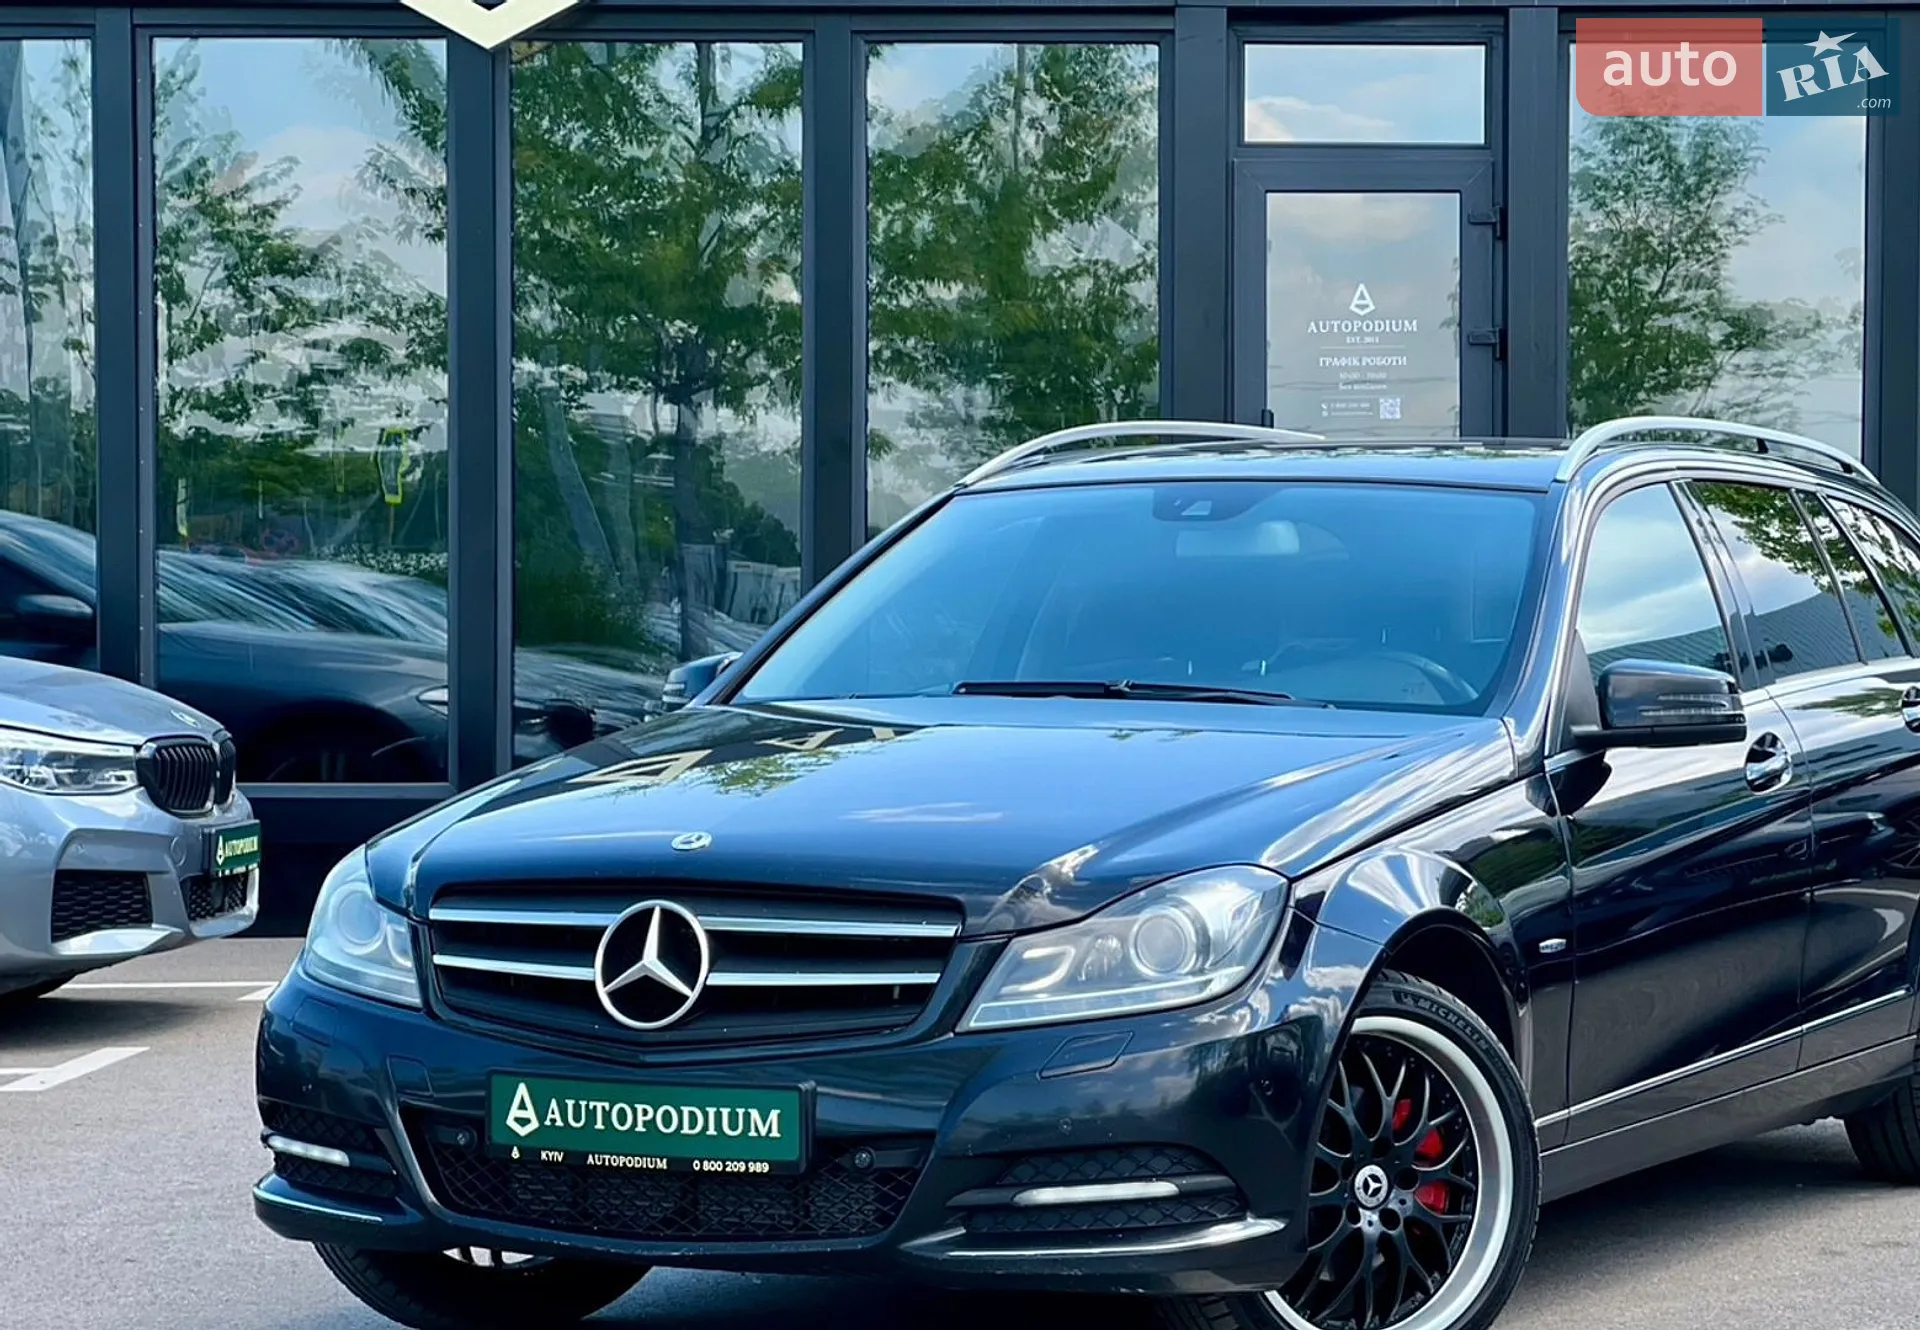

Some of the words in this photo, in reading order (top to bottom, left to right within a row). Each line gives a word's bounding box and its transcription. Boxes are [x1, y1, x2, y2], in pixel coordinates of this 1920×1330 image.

[1307, 319, 1418, 333] AUTOPODIUM
[1319, 356, 1360, 367] ГРАФІК
[1418, 998, 1490, 1051] MICHELIN
[543, 1098, 782, 1138] AUTOPODIUM
[540, 1149, 564, 1163] KYIV
[586, 1153, 668, 1170] AUTOPODIUM
[693, 1159, 701, 1171] 0
[702, 1159, 724, 1172] 800
[725, 1160, 746, 1173] 209
[748, 1160, 770, 1173] 989
